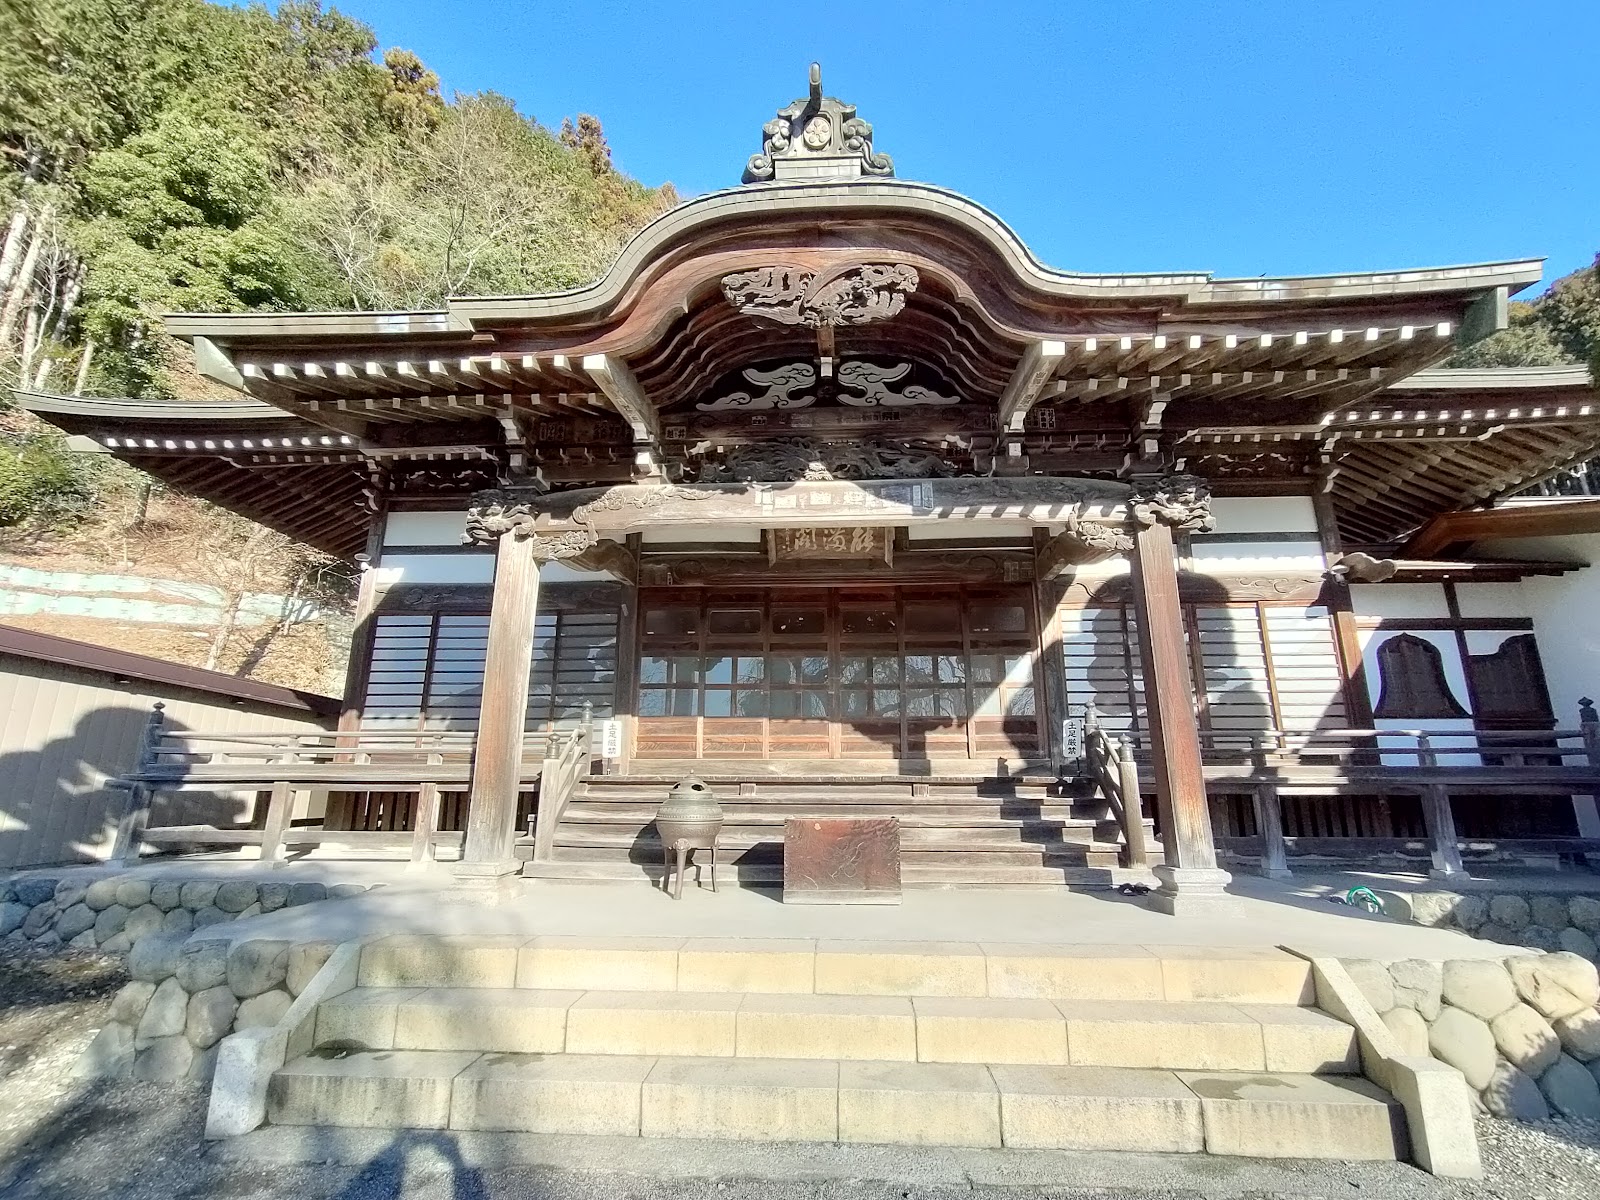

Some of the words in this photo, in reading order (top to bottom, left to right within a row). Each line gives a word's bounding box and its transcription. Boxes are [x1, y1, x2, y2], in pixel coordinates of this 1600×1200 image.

[608, 723, 617, 755] 土足厳禁
[1067, 722, 1077, 755] 土足厳禁
